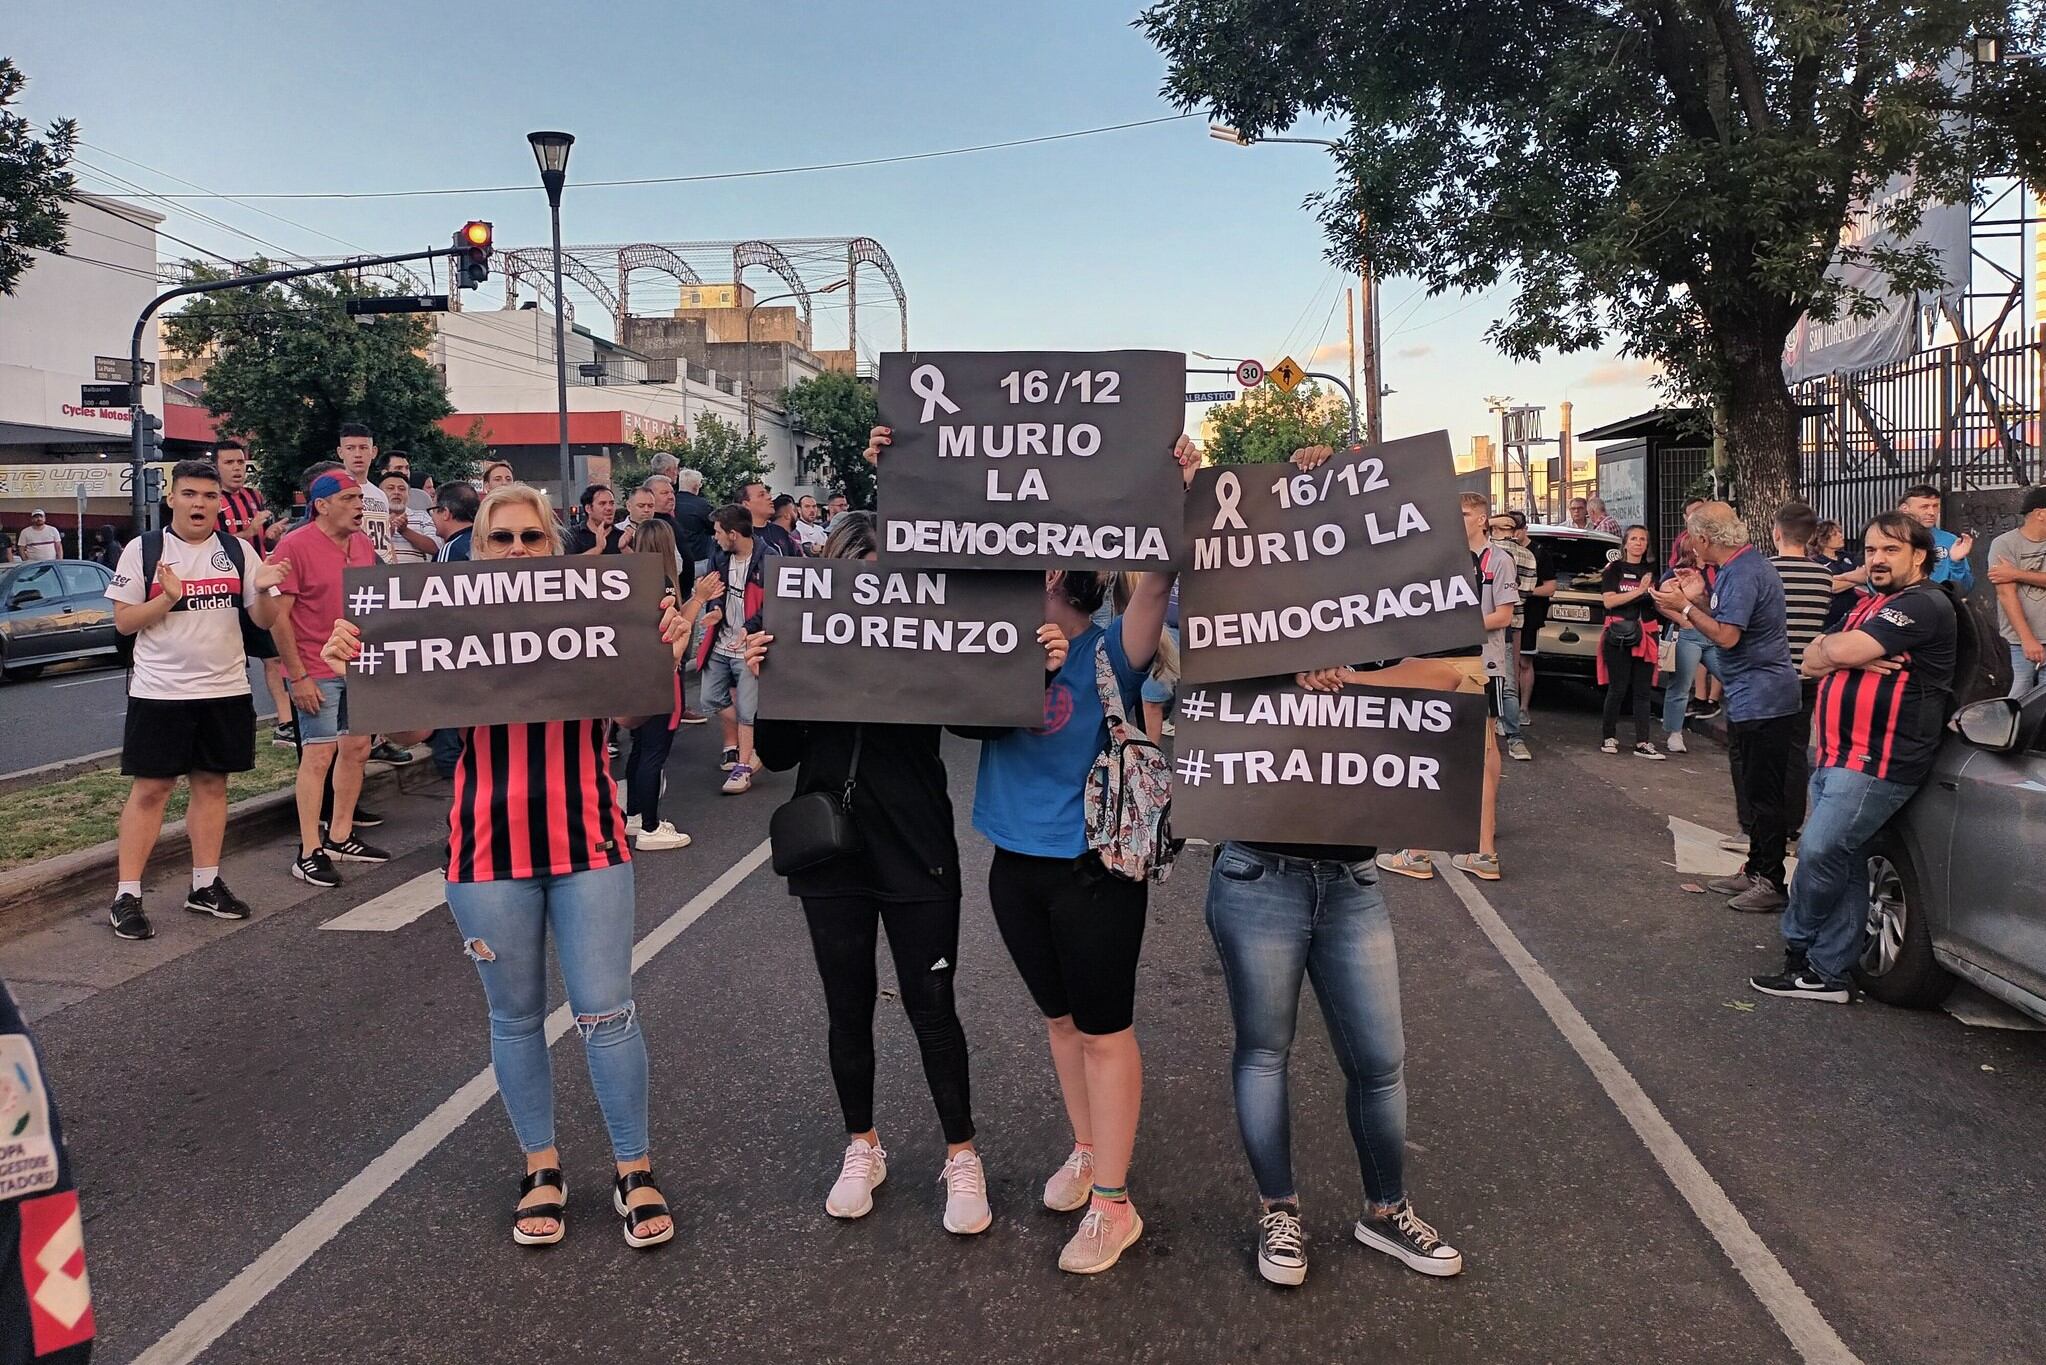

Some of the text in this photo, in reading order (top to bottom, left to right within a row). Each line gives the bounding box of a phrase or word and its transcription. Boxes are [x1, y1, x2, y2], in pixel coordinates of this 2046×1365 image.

[1809, 327, 1824, 352] SAN
[1825, 316, 1857, 347] LORENZO
[999, 370, 1121, 404] 16/12
[1242, 367, 1258, 380] 30
[62, 403, 96, 417] Cycles
[938, 423, 1102, 458] MURIO
[986, 468, 1049, 501] LA
[1271, 457, 1390, 509] 16/12
[886, 520, 1170, 561] DEMOCRACIA
[1194, 502, 1431, 571] MURIO LA
[186, 583, 228, 596] Banco
[187, 595, 232, 611] Ciudad
[348, 568, 631, 616] #LAMMENS
[777, 567, 946, 605] EN SAN
[1188, 575, 1479, 649] DEMOCRACIA
[349, 625, 618, 675] #TRAIDOR
[801, 612, 1018, 654] LORENZO
[1181, 690, 1452, 732] #LAMMENS
[1176, 749, 1441, 791] #TRAIDOR
